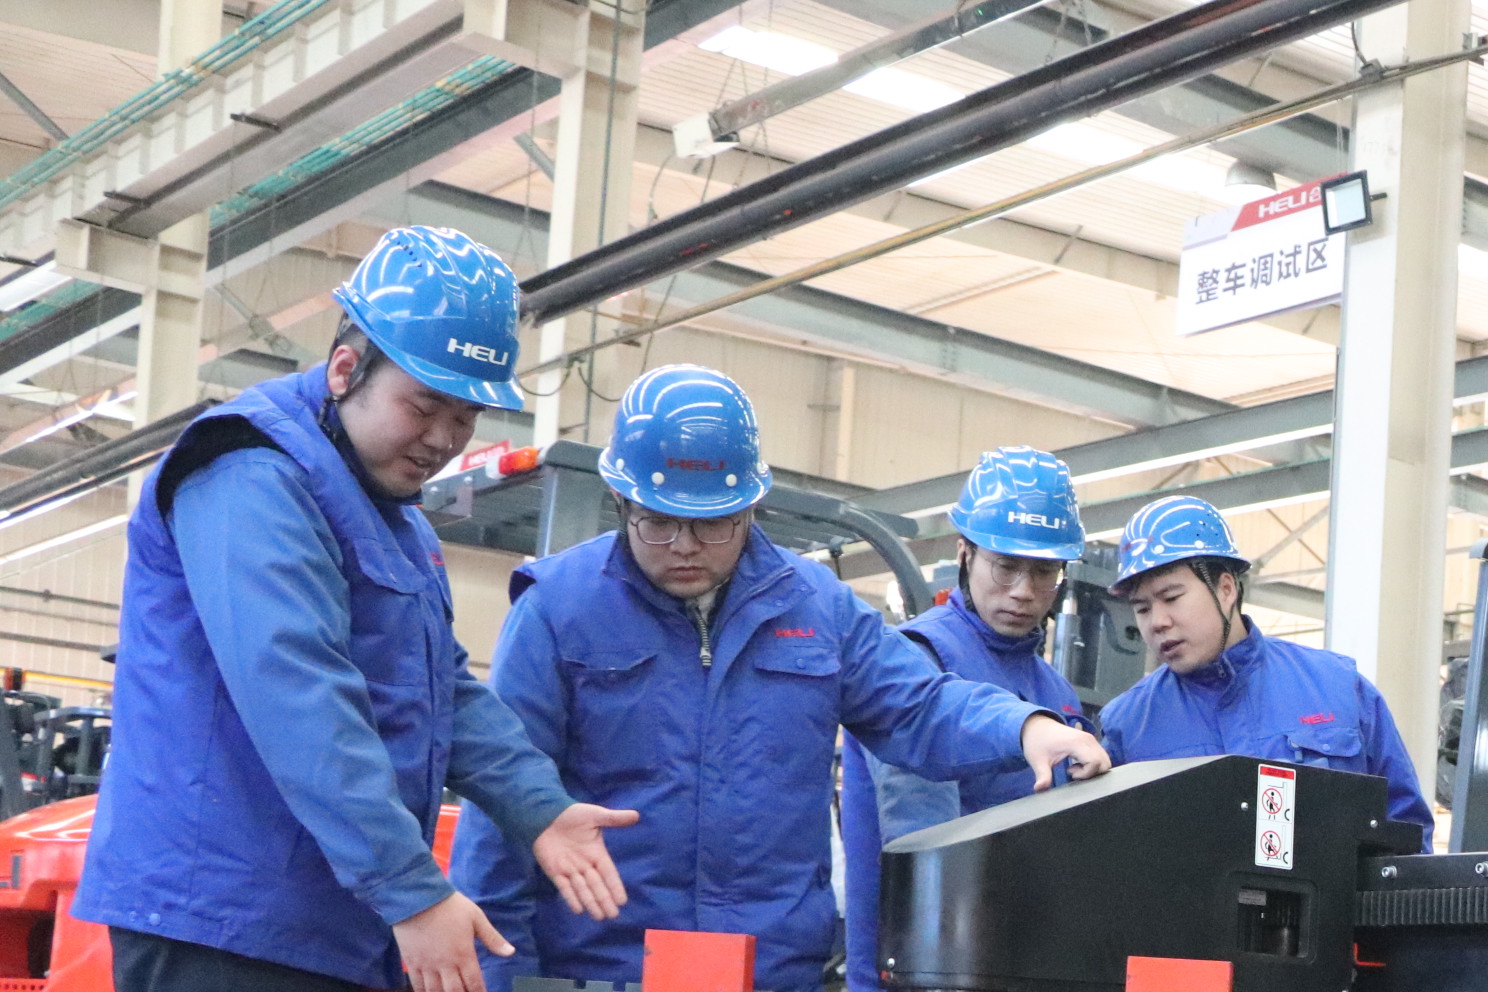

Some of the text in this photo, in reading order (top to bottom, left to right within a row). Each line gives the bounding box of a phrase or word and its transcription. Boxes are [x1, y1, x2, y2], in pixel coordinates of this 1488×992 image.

[1257, 190, 1307, 218] HELI
[1195, 237, 1330, 305] 整车调试区
[447, 337, 509, 366] HELI
[1007, 511, 1060, 529] HELI
